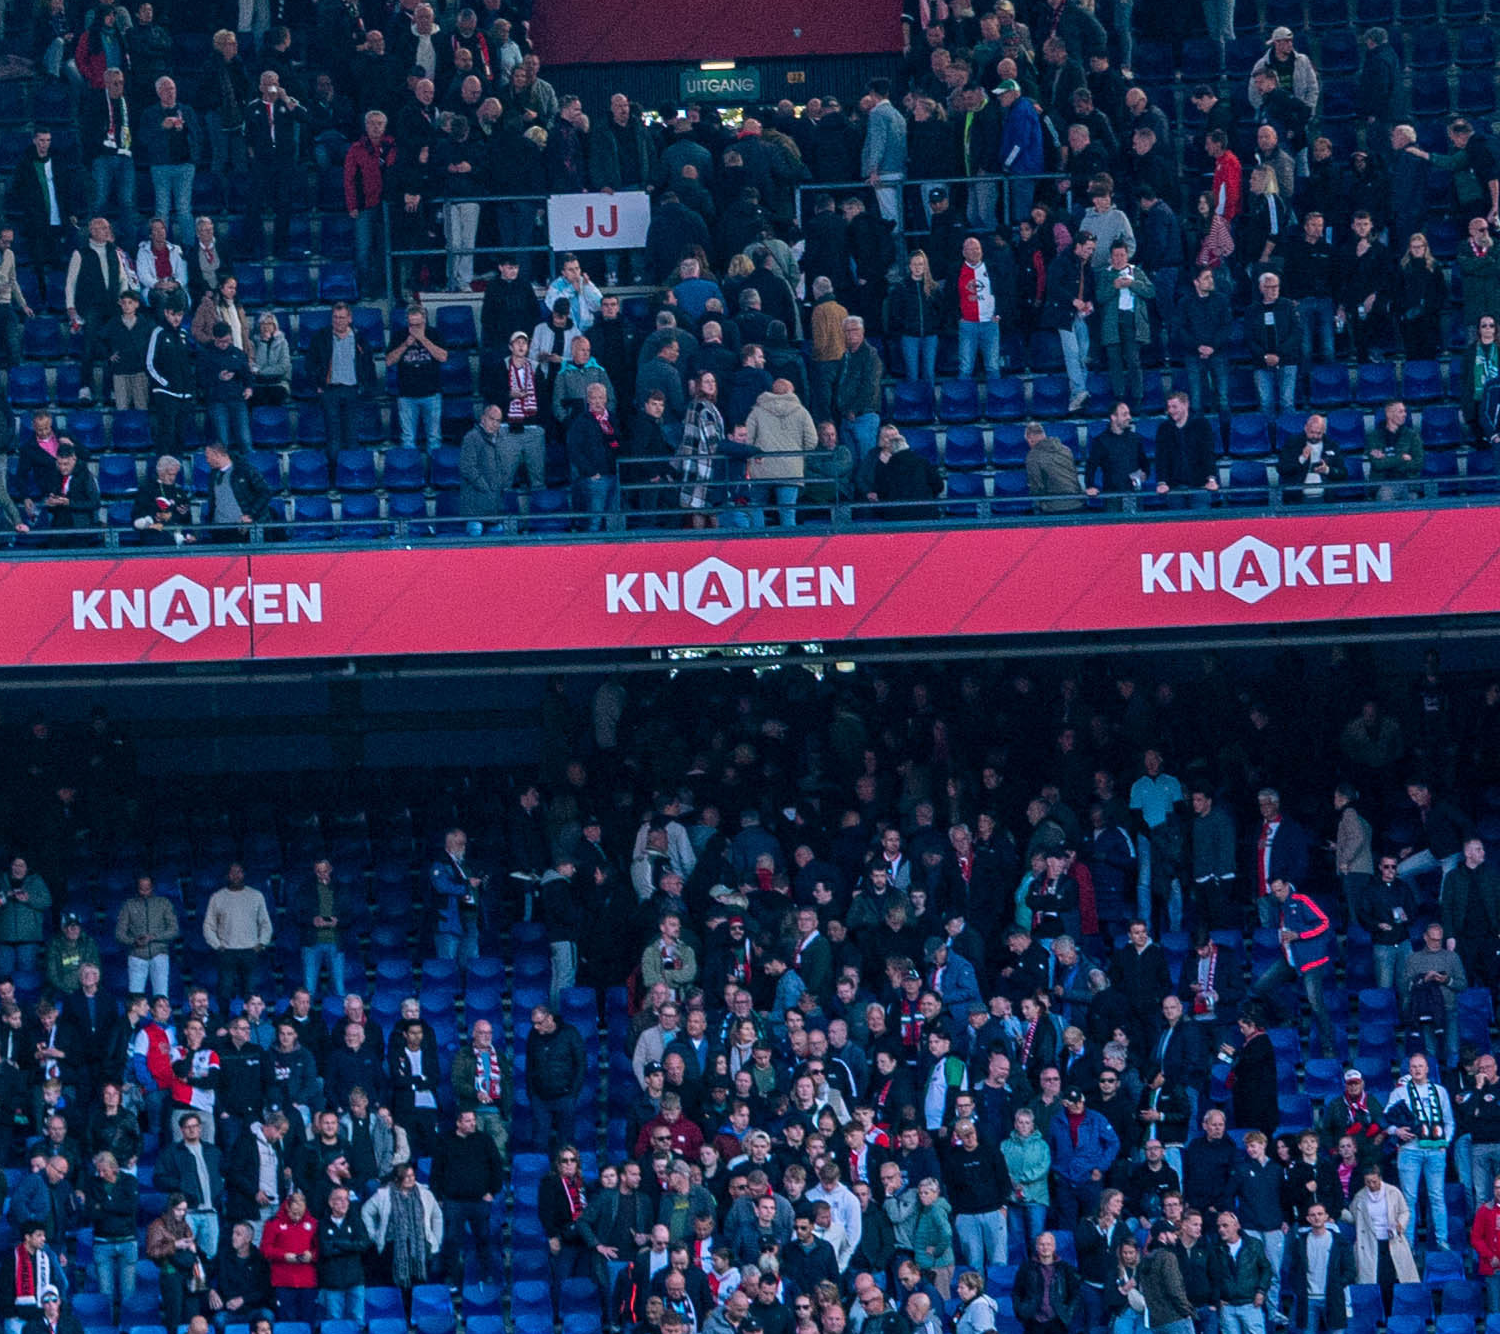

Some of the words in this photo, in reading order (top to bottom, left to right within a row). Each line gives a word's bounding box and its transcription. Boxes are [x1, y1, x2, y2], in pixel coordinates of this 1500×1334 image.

[686, 76, 755, 94] UITGANG
[573, 204, 618, 238] JJ
[605, 565, 855, 615] KNAKEN
[1140, 542, 1391, 593] KNAKEN
[72, 581, 321, 630] KNAKEN
